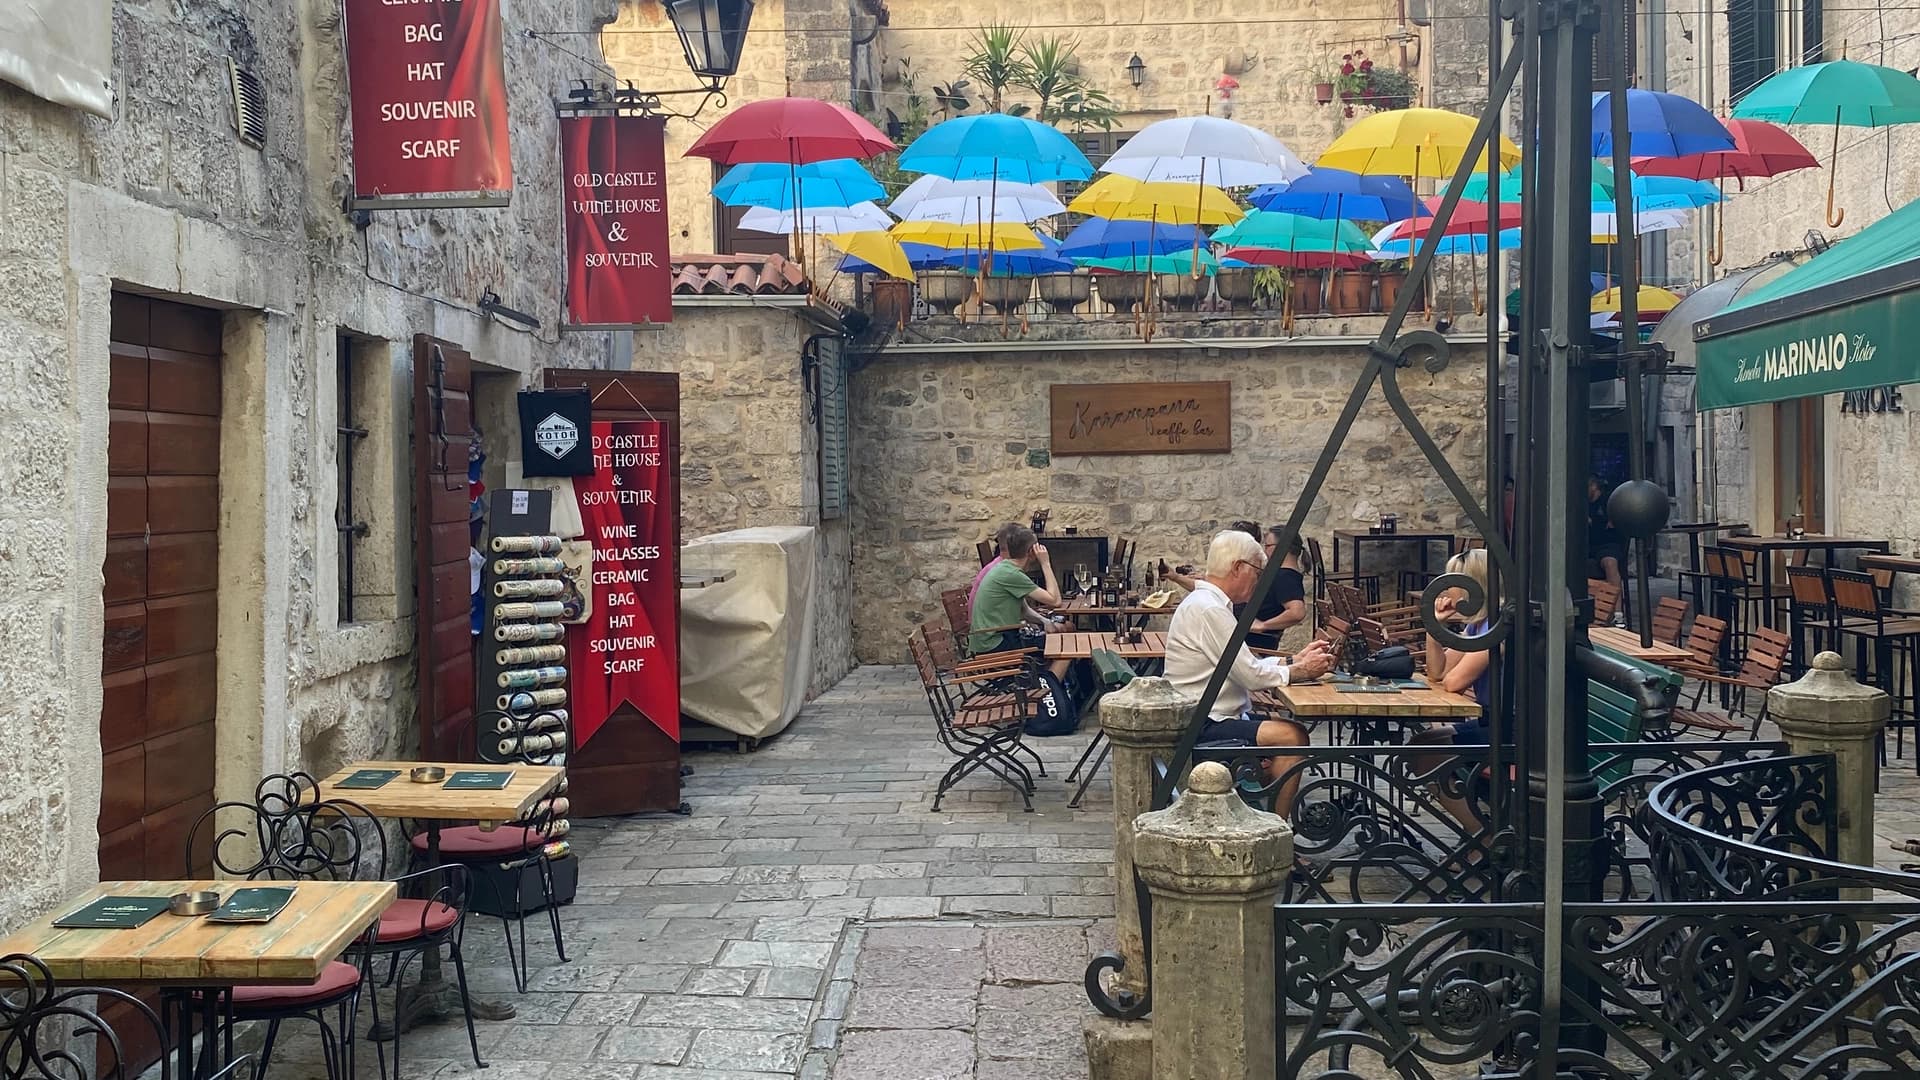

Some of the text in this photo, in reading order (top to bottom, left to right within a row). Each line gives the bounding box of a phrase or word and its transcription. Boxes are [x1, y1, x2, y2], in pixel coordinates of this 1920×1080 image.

[404, 23, 443, 43] BAG
[407, 62, 445, 82] HAT
[380, 99, 476, 122] SOUVENIR
[401, 139, 461, 159] SCARF
[573, 171, 658, 188] OLD CASTLE
[573, 198, 661, 217] WINE HOUSE
[607, 221, 630, 242] &
[585, 252, 659, 269] SOUVENIR
[1763, 332, 1848, 383] MARINAIO
[537, 431, 577, 441] KOTOR
[604, 434, 659, 450] CASTLE
[593, 452, 661, 471] NE HOUSE
[611, 474, 624, 487] &
[582, 489, 658, 507] SOUVENIR
[600, 524, 638, 540] WINE
[592, 568, 650, 585] CERAMIC
[608, 591, 636, 608] BAG
[609, 614, 636, 630] HAT
[590, 635, 657, 654] SOUVENIR
[603, 658, 645, 675] SCARF
[1038, 677, 1058, 718] adias
